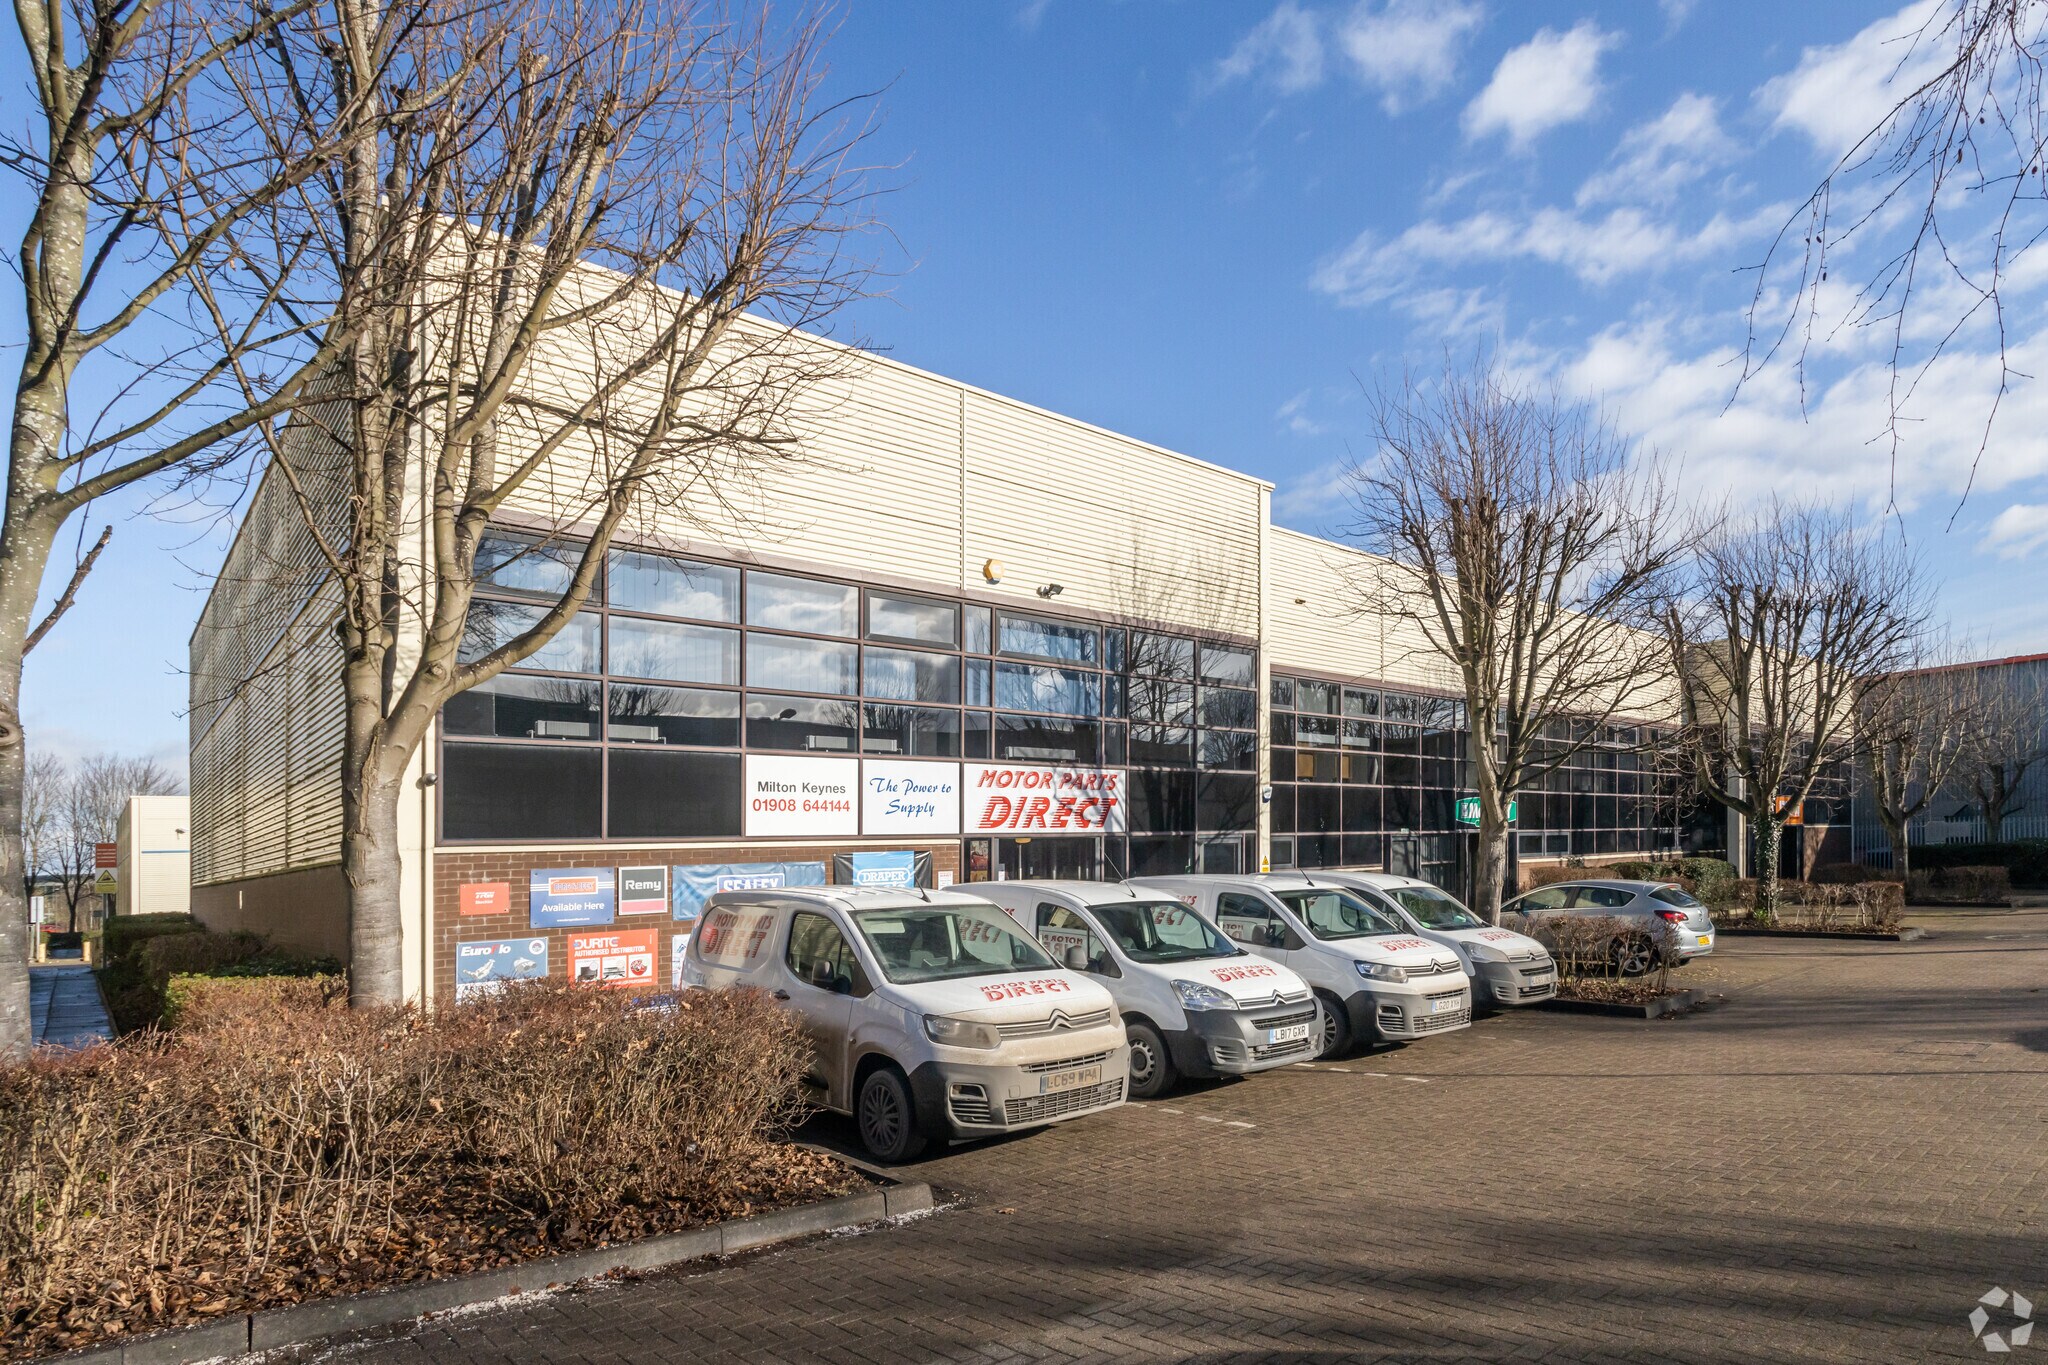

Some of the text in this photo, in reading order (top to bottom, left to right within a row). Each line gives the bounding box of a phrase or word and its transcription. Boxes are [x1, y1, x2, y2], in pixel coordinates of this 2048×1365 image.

[869, 777, 952, 796] The Power to
[977, 769, 1118, 791] MOTOR PARTS
[757, 781, 846, 796] Milton Keynes
[752, 798, 850, 812] 01908 644144
[885, 799, 935, 817] Supply
[974, 795, 1118, 829] DIRECT
[861, 870, 906, 882] DRAPER
[625, 880, 662, 891] Remy
[541, 902, 605, 912] Available Here
[714, 913, 746, 928] MOTOR
[461, 943, 511, 957] EuroFlo
[704, 928, 768, 959] DIRECT
[574, 945, 646, 957] AUTHORISED DISTRIBUTOR
[1210, 966, 1242, 975] MOTOR
[1216, 968, 1277, 982] DIRECT
[980, 980, 1027, 992] MOTOR
[984, 982, 1071, 1002] DIRECT
[1275, 1025, 1306, 1040] LB17 GXR
